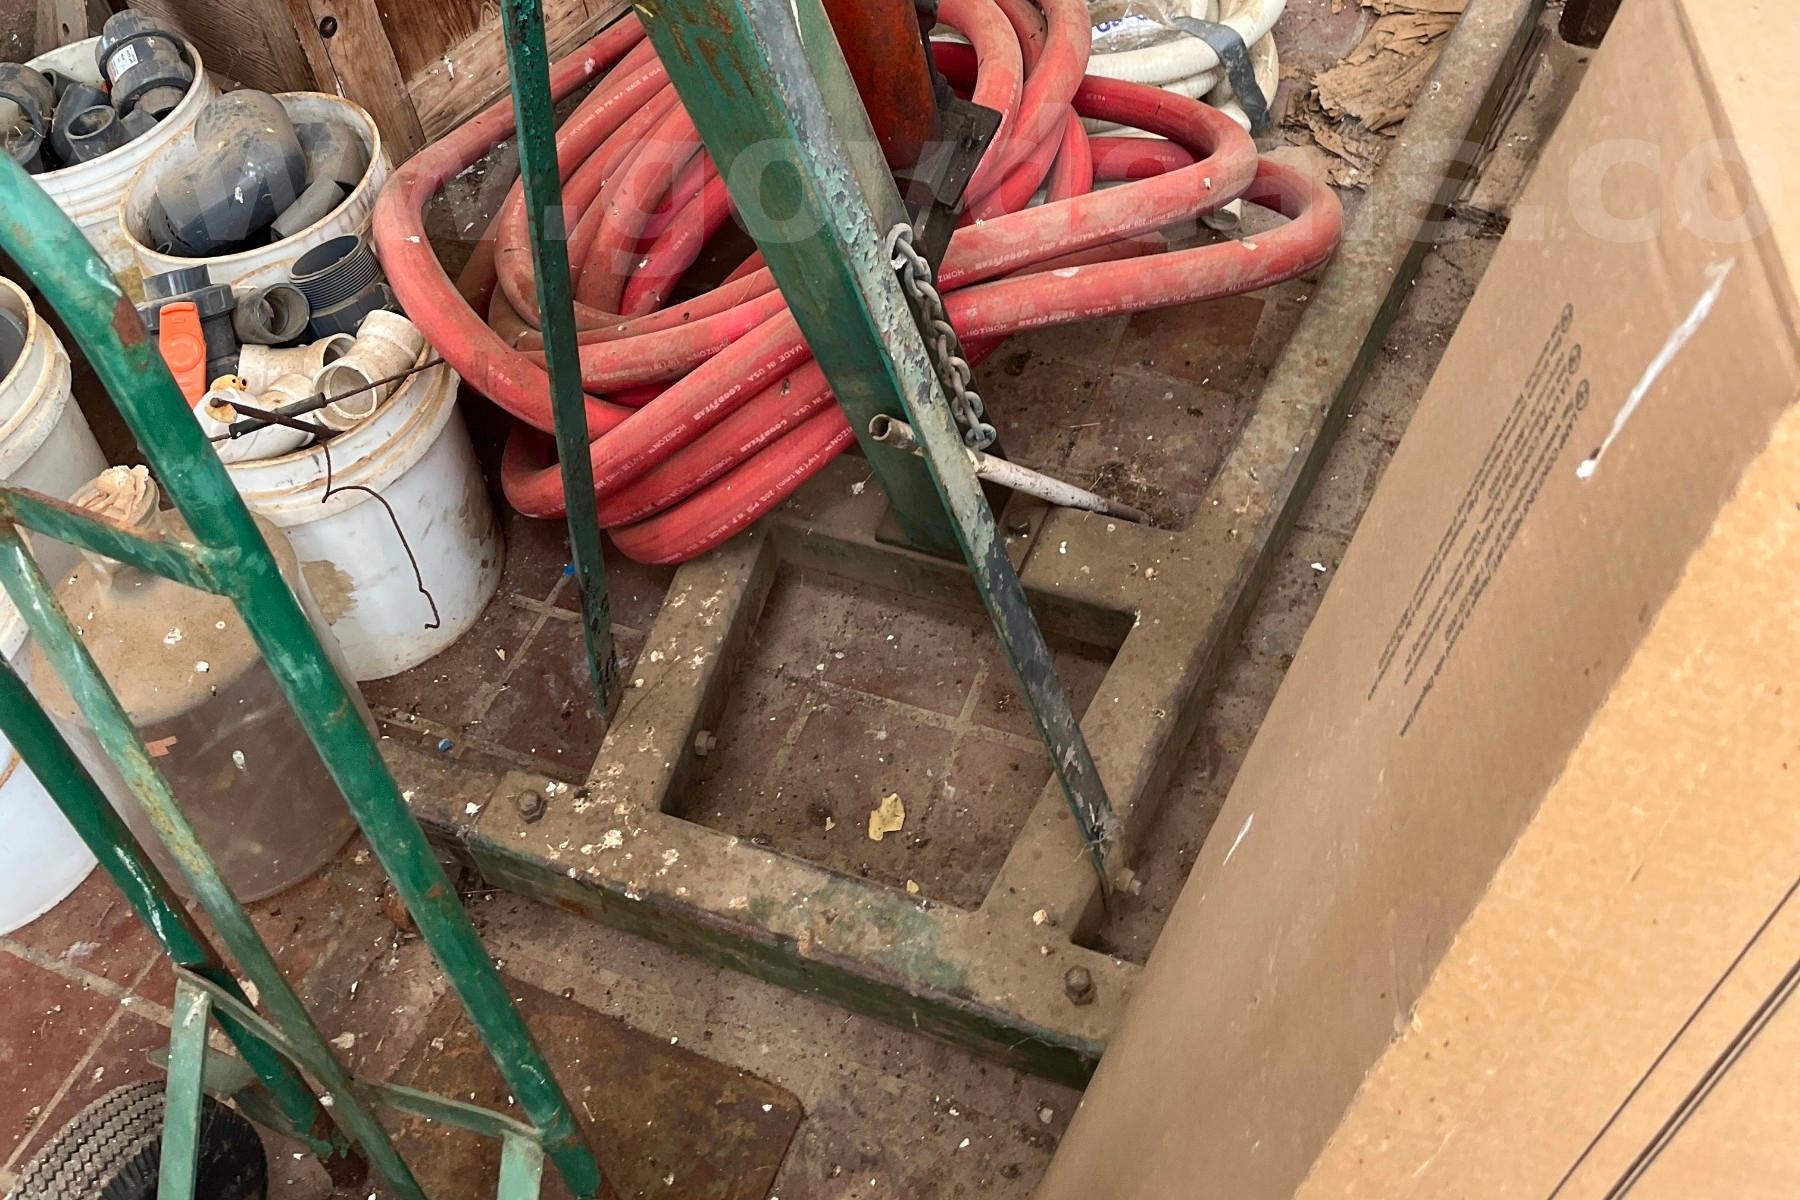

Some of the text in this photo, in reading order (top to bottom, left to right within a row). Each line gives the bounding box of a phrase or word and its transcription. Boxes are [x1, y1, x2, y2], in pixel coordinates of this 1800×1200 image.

[975, 248, 1030, 270] GOODYEAR
[1085, 305, 1104, 316] USA
[1120, 300, 1146, 311] MADE
[1018, 309, 1076, 328] GOODYEAR
[777, 343, 803, 363] MADE
[766, 361, 777, 371] IN
[747, 368, 766, 382] USA
[692, 384, 742, 421] GOODYEAR
[793, 404, 811, 417] USA
[740, 419, 788, 453] GOODYEAR
